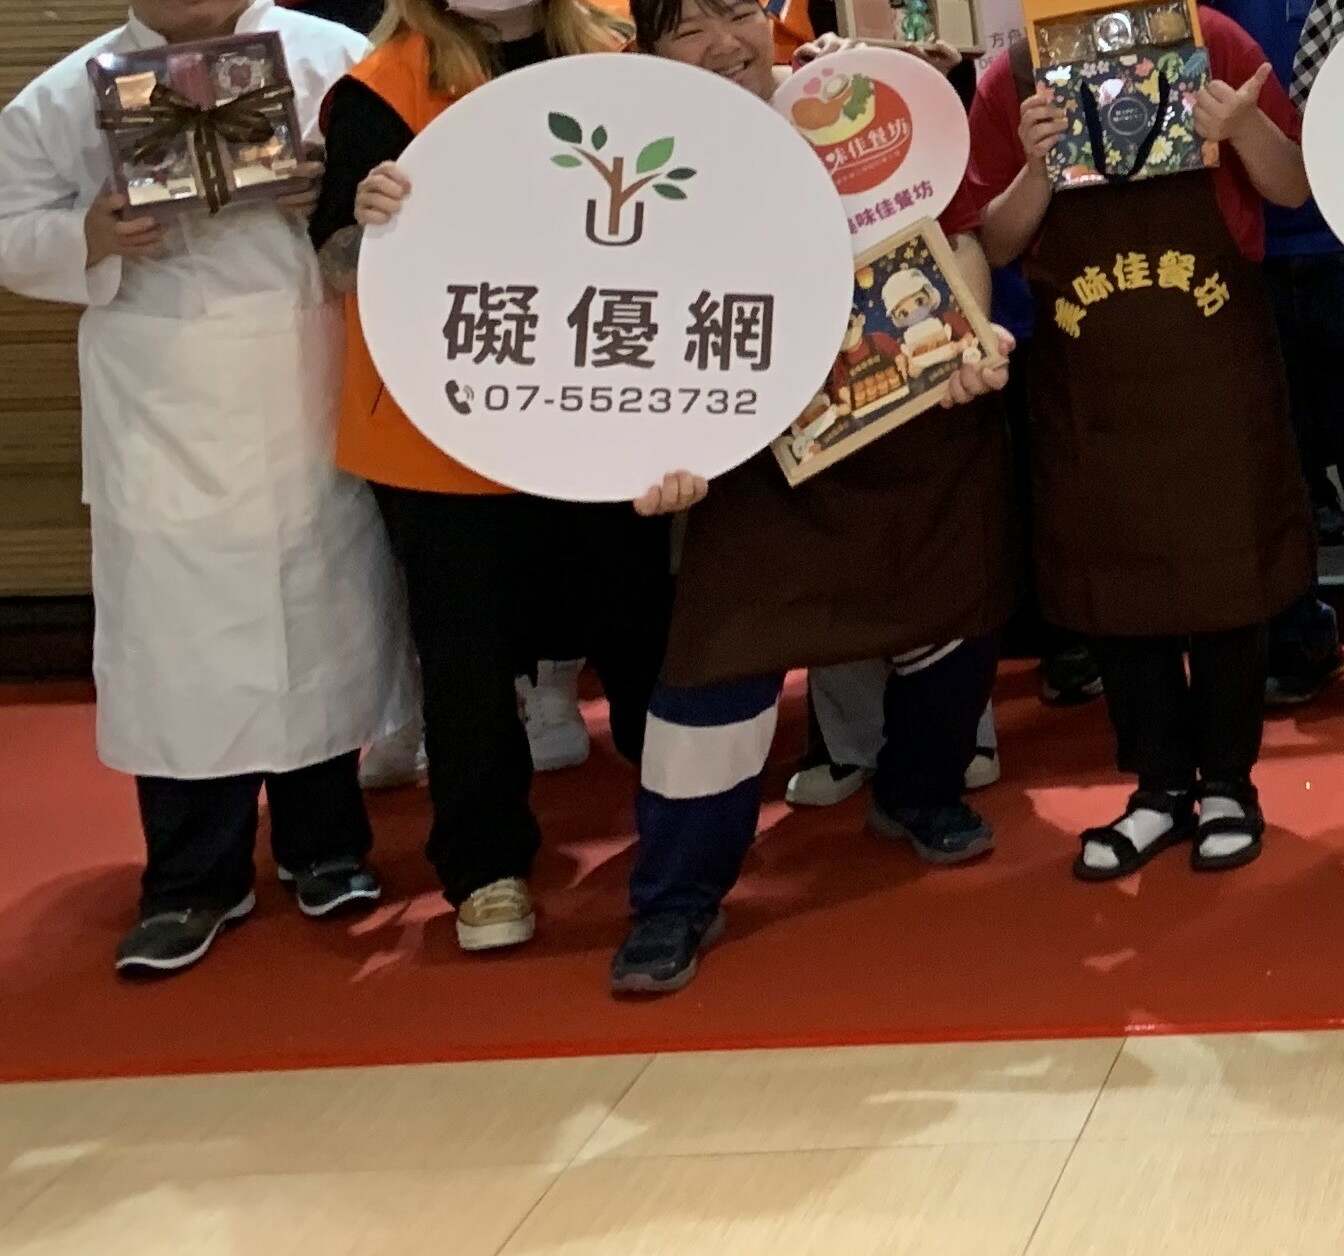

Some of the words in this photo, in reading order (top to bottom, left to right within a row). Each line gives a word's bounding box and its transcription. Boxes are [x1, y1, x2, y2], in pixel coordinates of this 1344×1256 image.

[441, 281, 775, 372] 礙優網
[1054, 249, 1230, 339] 美味佳餐坊
[484, 384, 758, 416] 07-5523732
